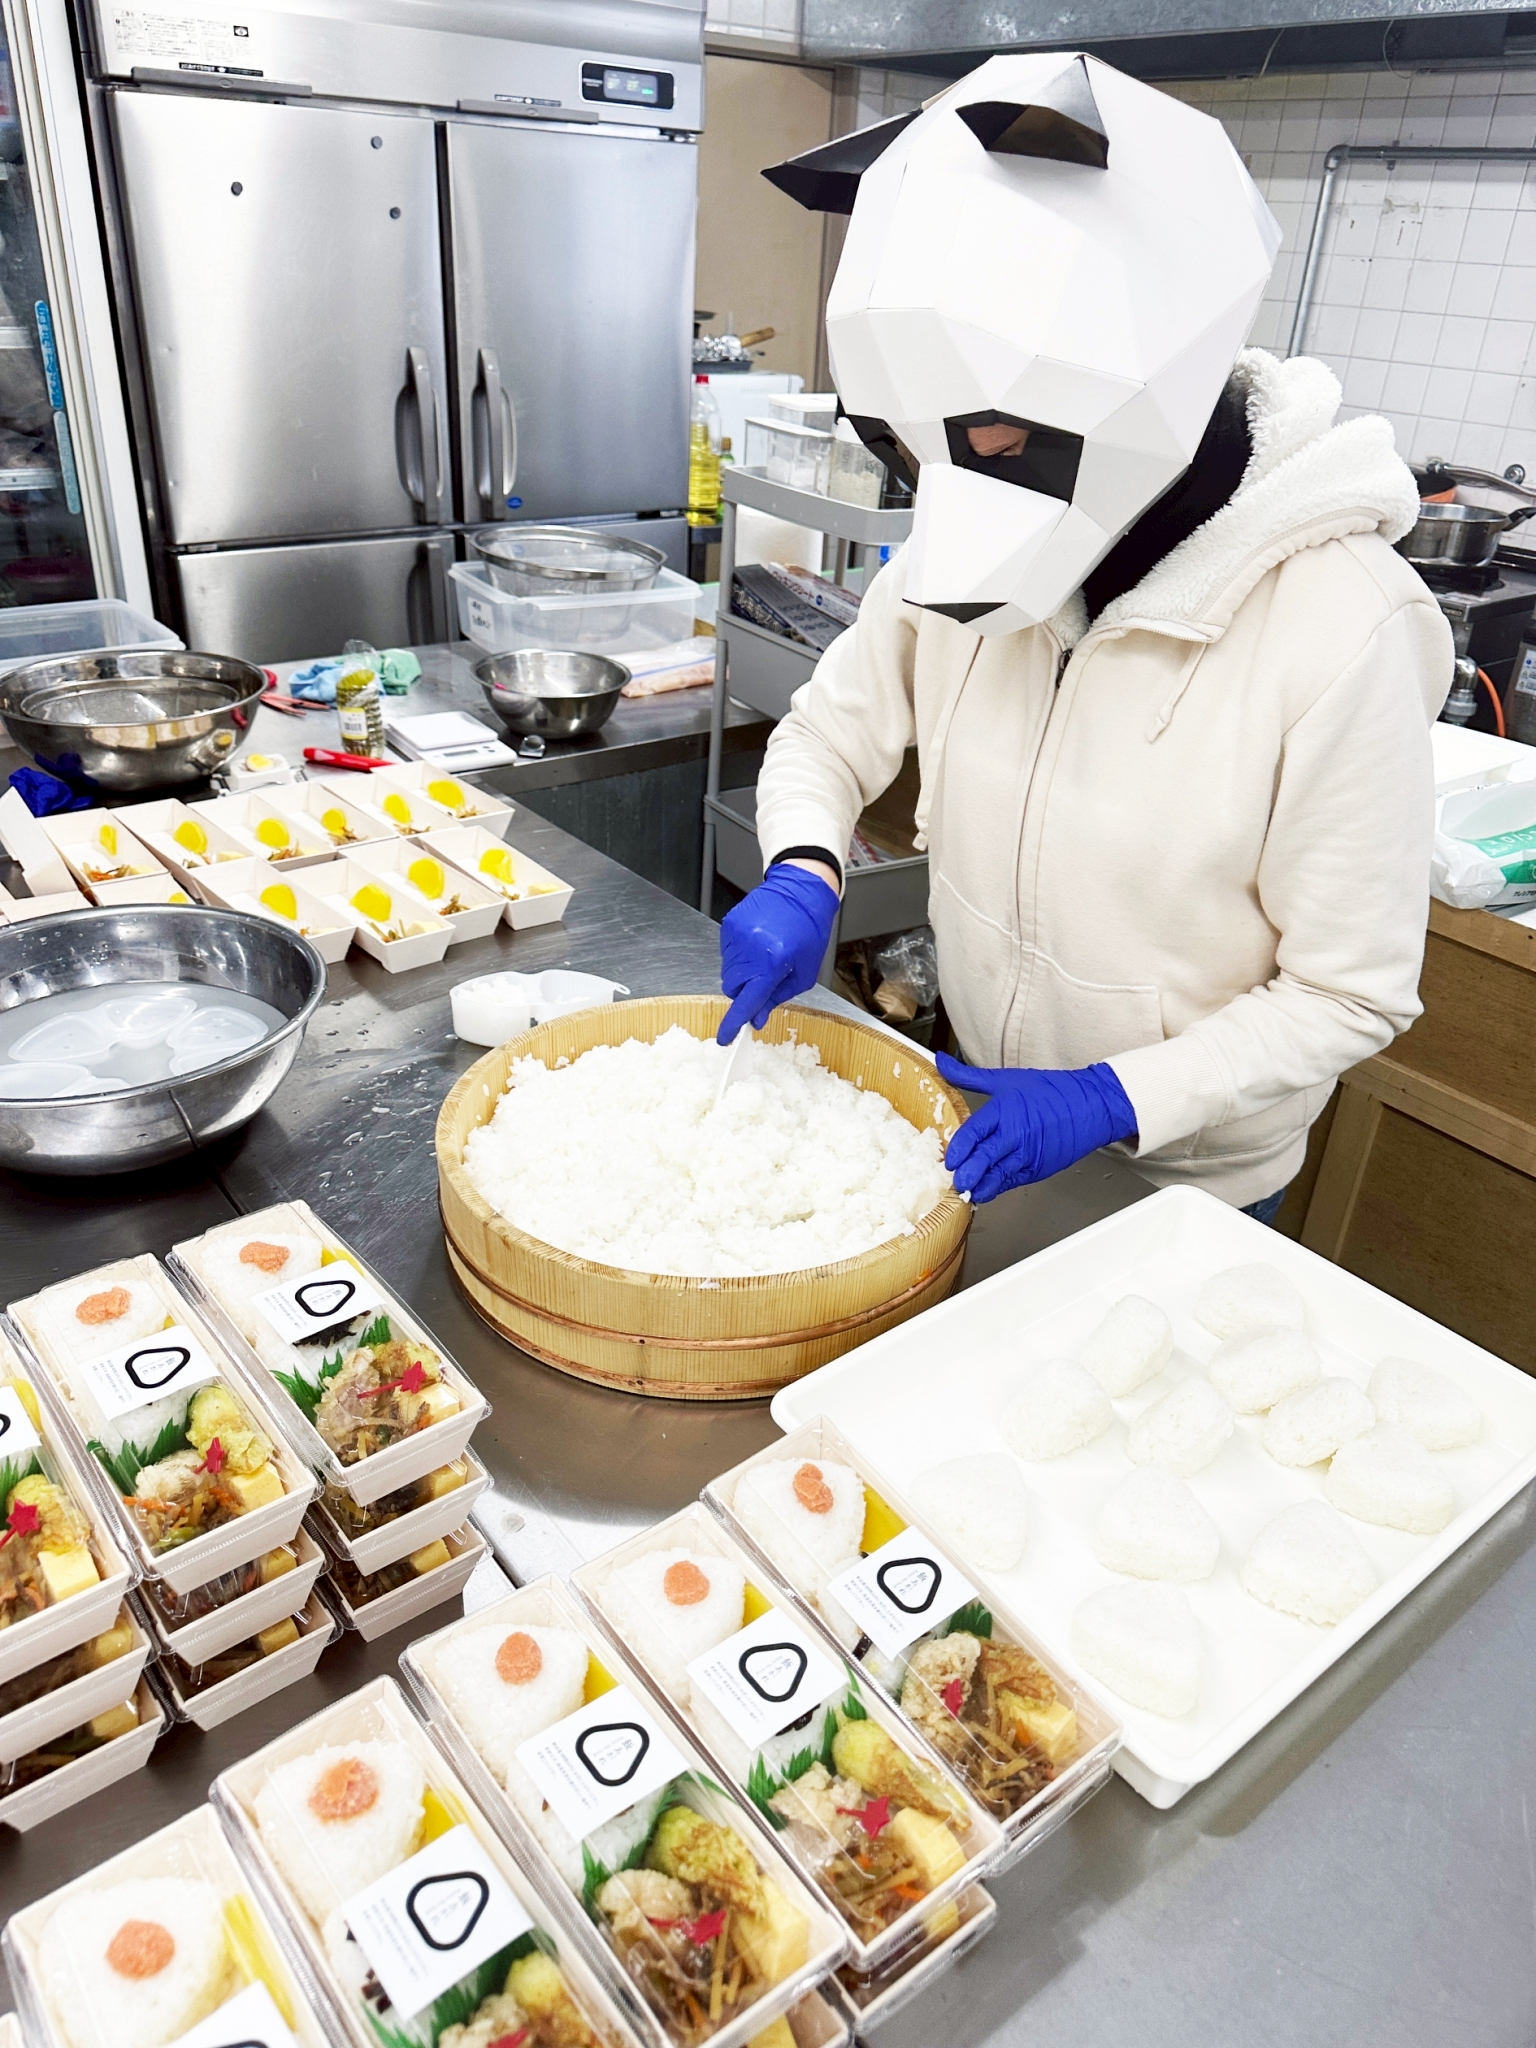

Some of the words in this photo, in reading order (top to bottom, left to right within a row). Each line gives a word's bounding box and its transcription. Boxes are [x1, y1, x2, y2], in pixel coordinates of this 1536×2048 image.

[897, 1571, 929, 1596] 飯あがれ
[760, 1657, 794, 1684] 飯あがれ
[596, 1738, 634, 1766] 飯あがれ
